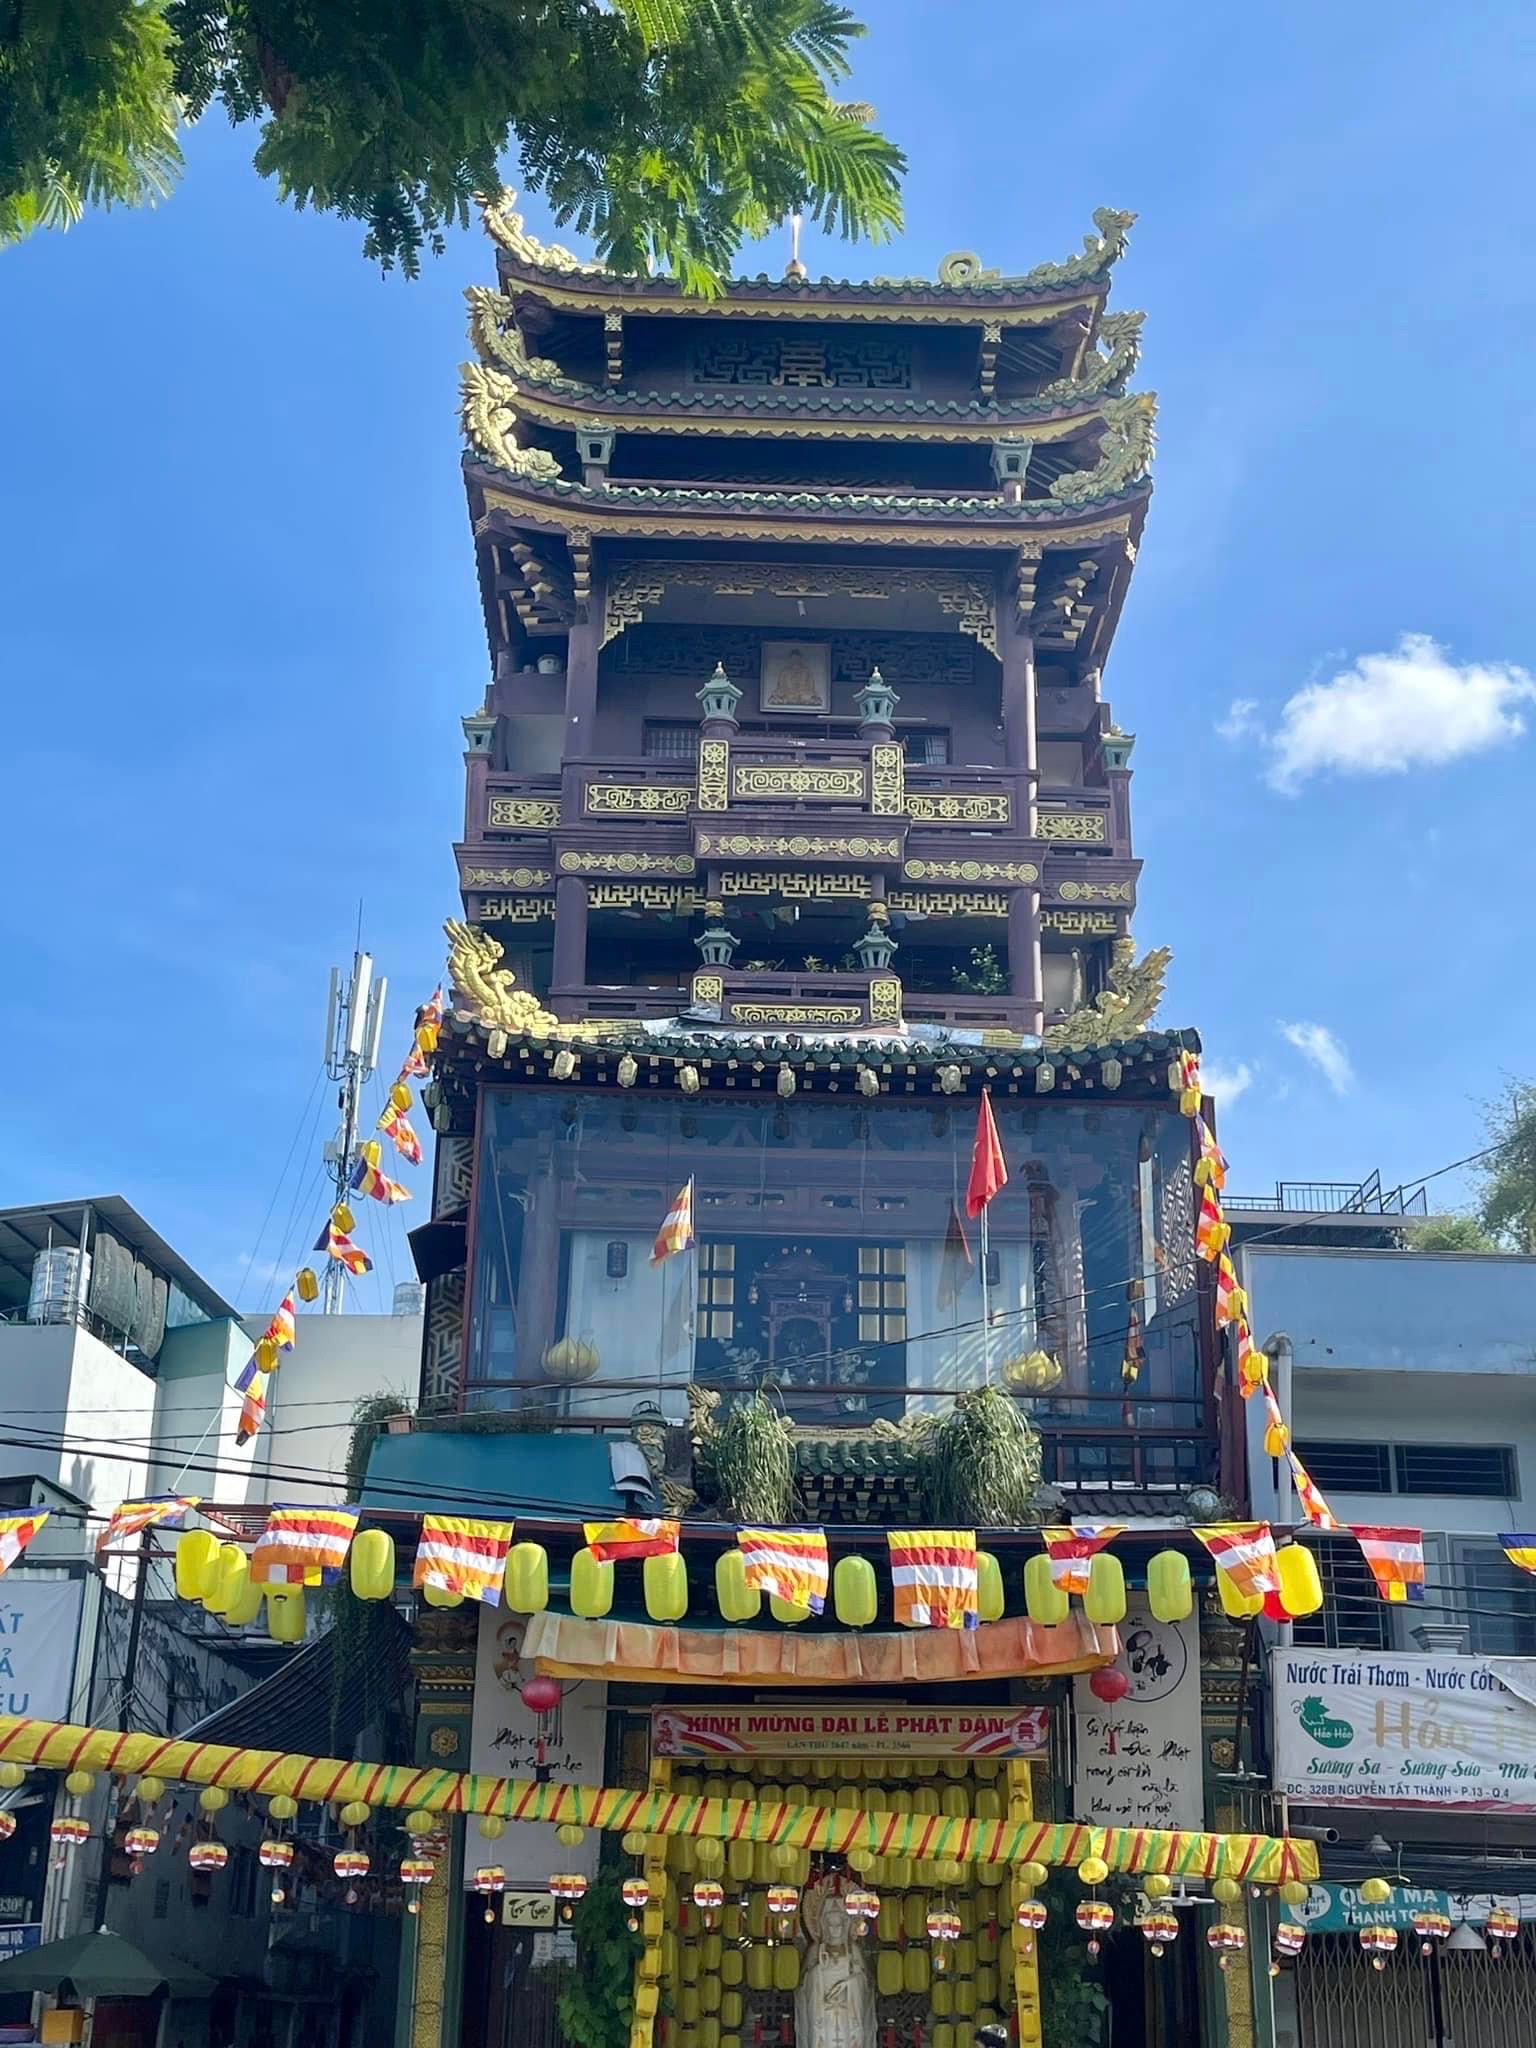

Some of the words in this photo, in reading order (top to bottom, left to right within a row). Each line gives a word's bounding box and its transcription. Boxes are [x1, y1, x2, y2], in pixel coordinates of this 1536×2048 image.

[1286, 1660, 1327, 1684] Nước
[1332, 1662, 1361, 1685] Trái
[1367, 1664, 1409, 1687] Thơm
[1425, 1666, 1466, 1690] Nước
[687, 1713, 741, 1732] KÍNH
[747, 1712, 814, 1732] MỪNG
[821, 1716, 857, 1736] ĐẠI
[863, 1711, 889, 1733] LỄ
[896, 1713, 952, 1736] PHẬT
[958, 1712, 1004, 1733] ĐẢN
[1358, 1758, 1381, 1776] Sa
[1309, 1784, 1335, 1795] 328B
[1338, 1780, 1386, 1796] NGUYỄN
